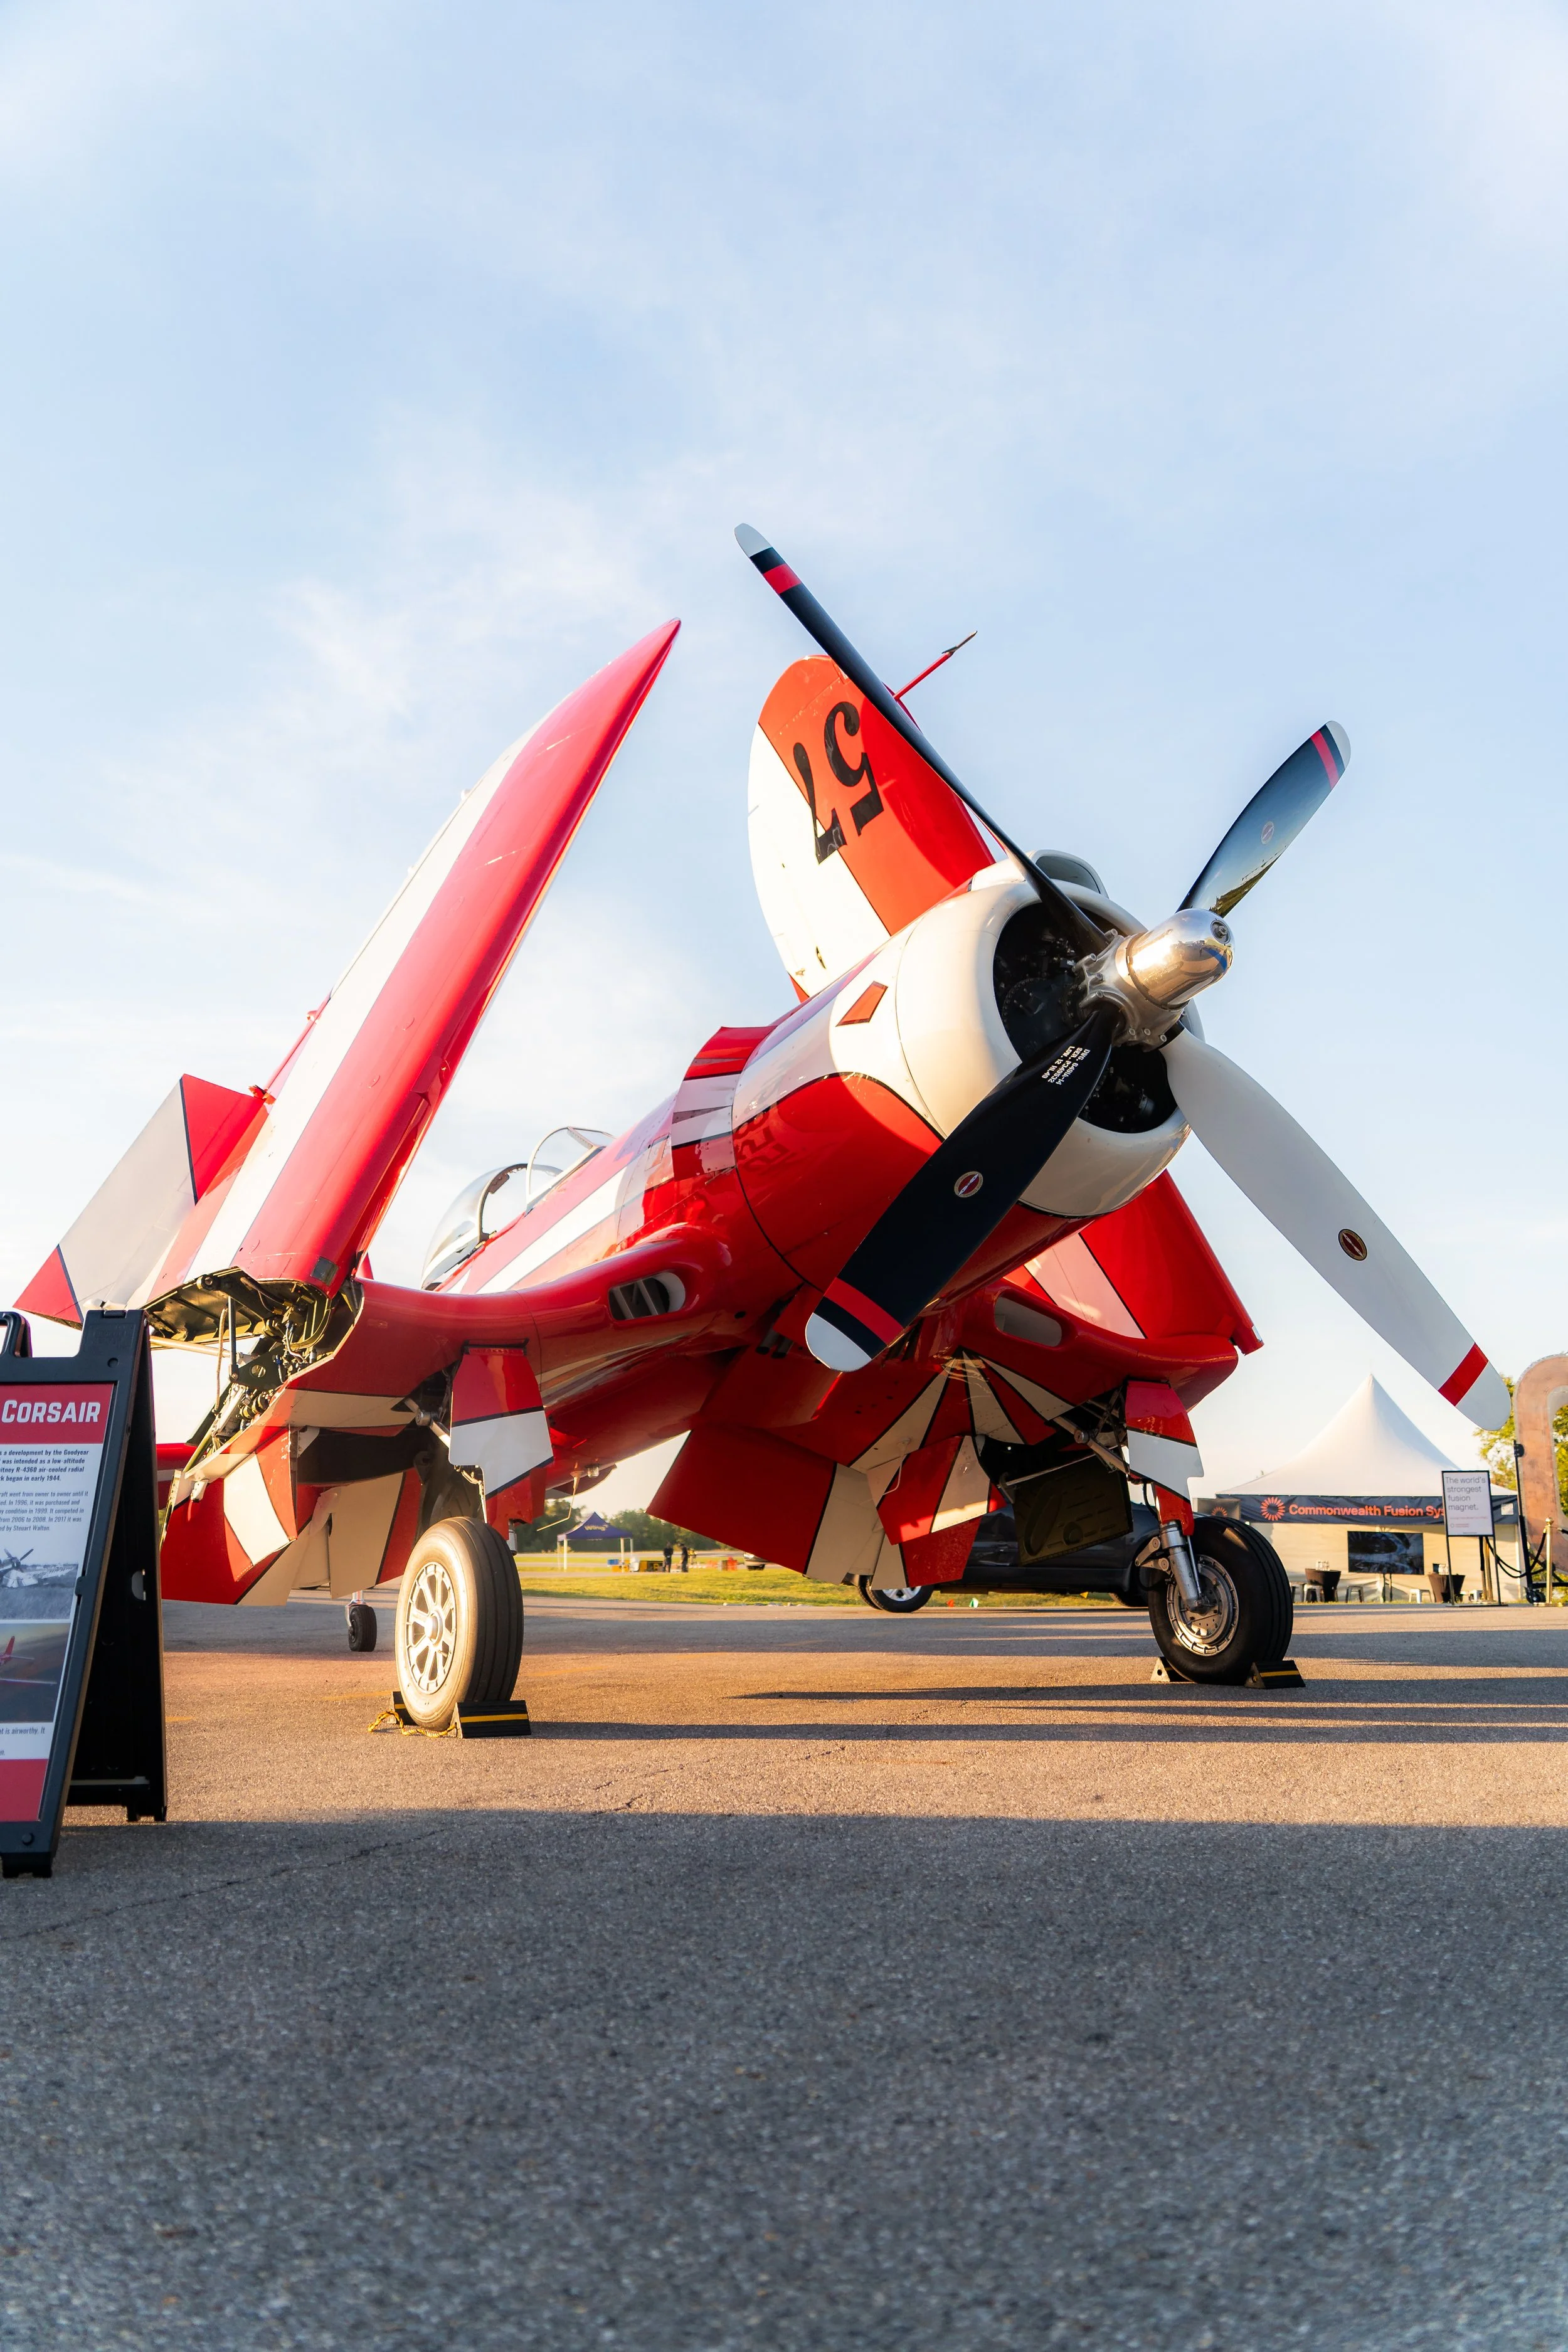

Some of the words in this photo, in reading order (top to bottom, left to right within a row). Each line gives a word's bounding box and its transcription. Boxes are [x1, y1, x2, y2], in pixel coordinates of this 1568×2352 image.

[793, 701, 884, 864] 57
[1061, 1046, 1075, 1058] LOW.
[1069, 1047, 1083, 1059] SER.
[1076, 1049, 1091, 1061] DWG.
[1289, 1504, 1380, 1516] Commonwealth
[1384, 1505, 1423, 1517] Fusion
[1448, 1504, 1479, 1512] magnet.
[12, 1727, 38, 1735] airworthy.
